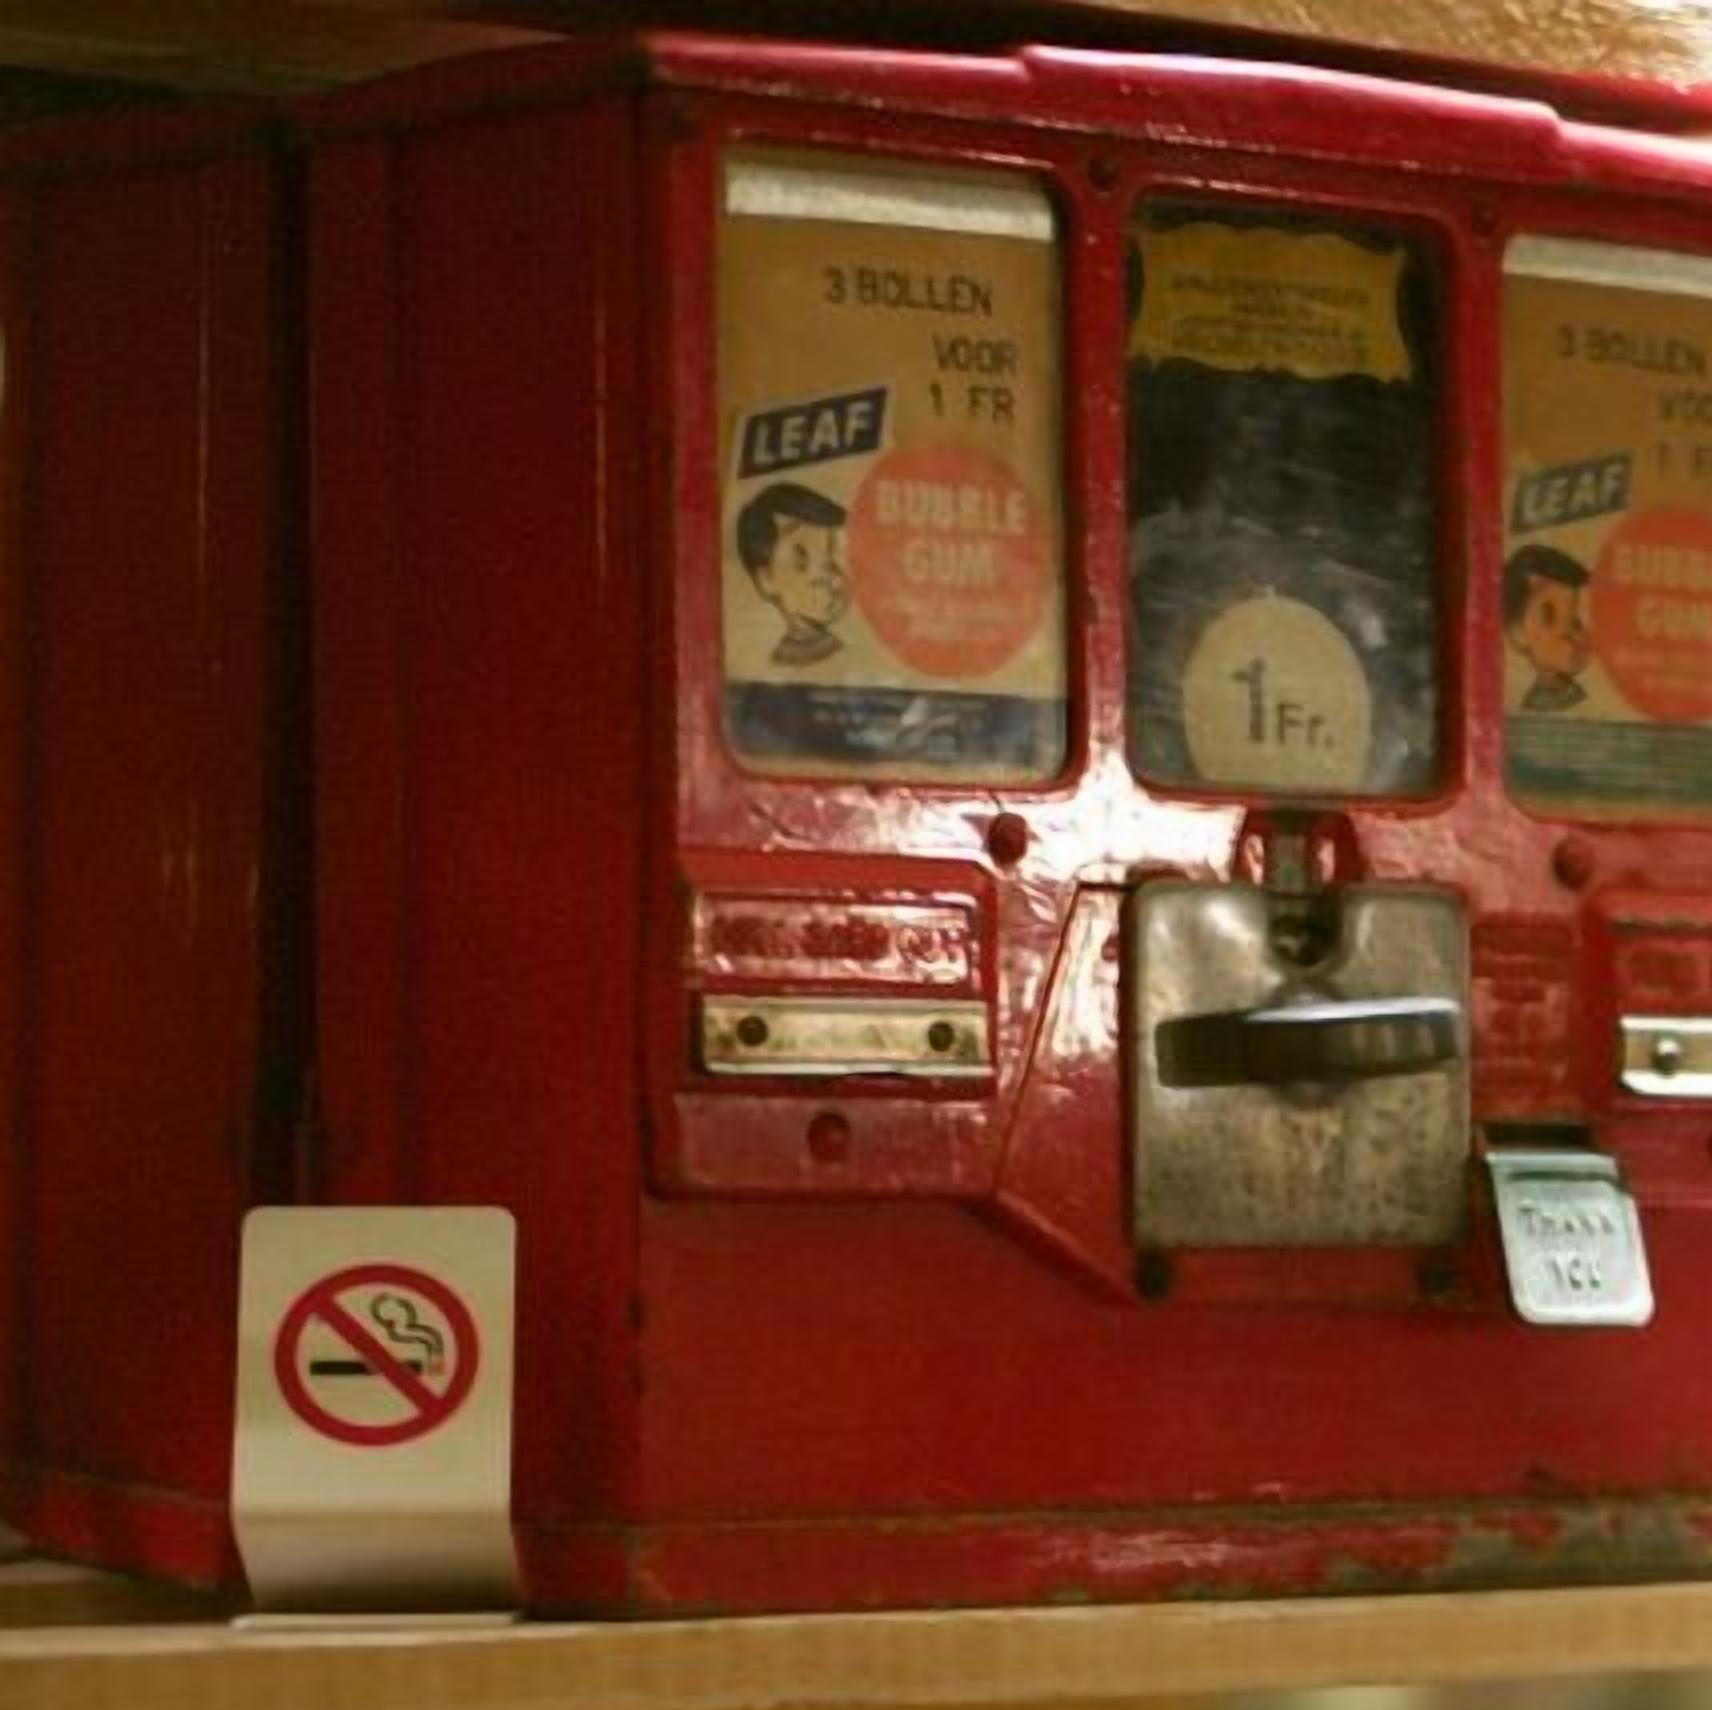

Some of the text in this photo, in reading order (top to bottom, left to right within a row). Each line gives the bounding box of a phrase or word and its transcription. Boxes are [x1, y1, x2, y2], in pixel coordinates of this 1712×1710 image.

[824, 266, 993, 317] 3 BOLLEN
[931, 333, 1018, 376] VOOR
[1585, 327, 1707, 376] BOLLEN
[929, 379, 1015, 424] 1 FR
[751, 401, 878, 466] LEAF
[875, 480, 1026, 535] BUBBLE
[1520, 465, 1628, 523] LEAF
[904, 540, 994, 587] GUM
